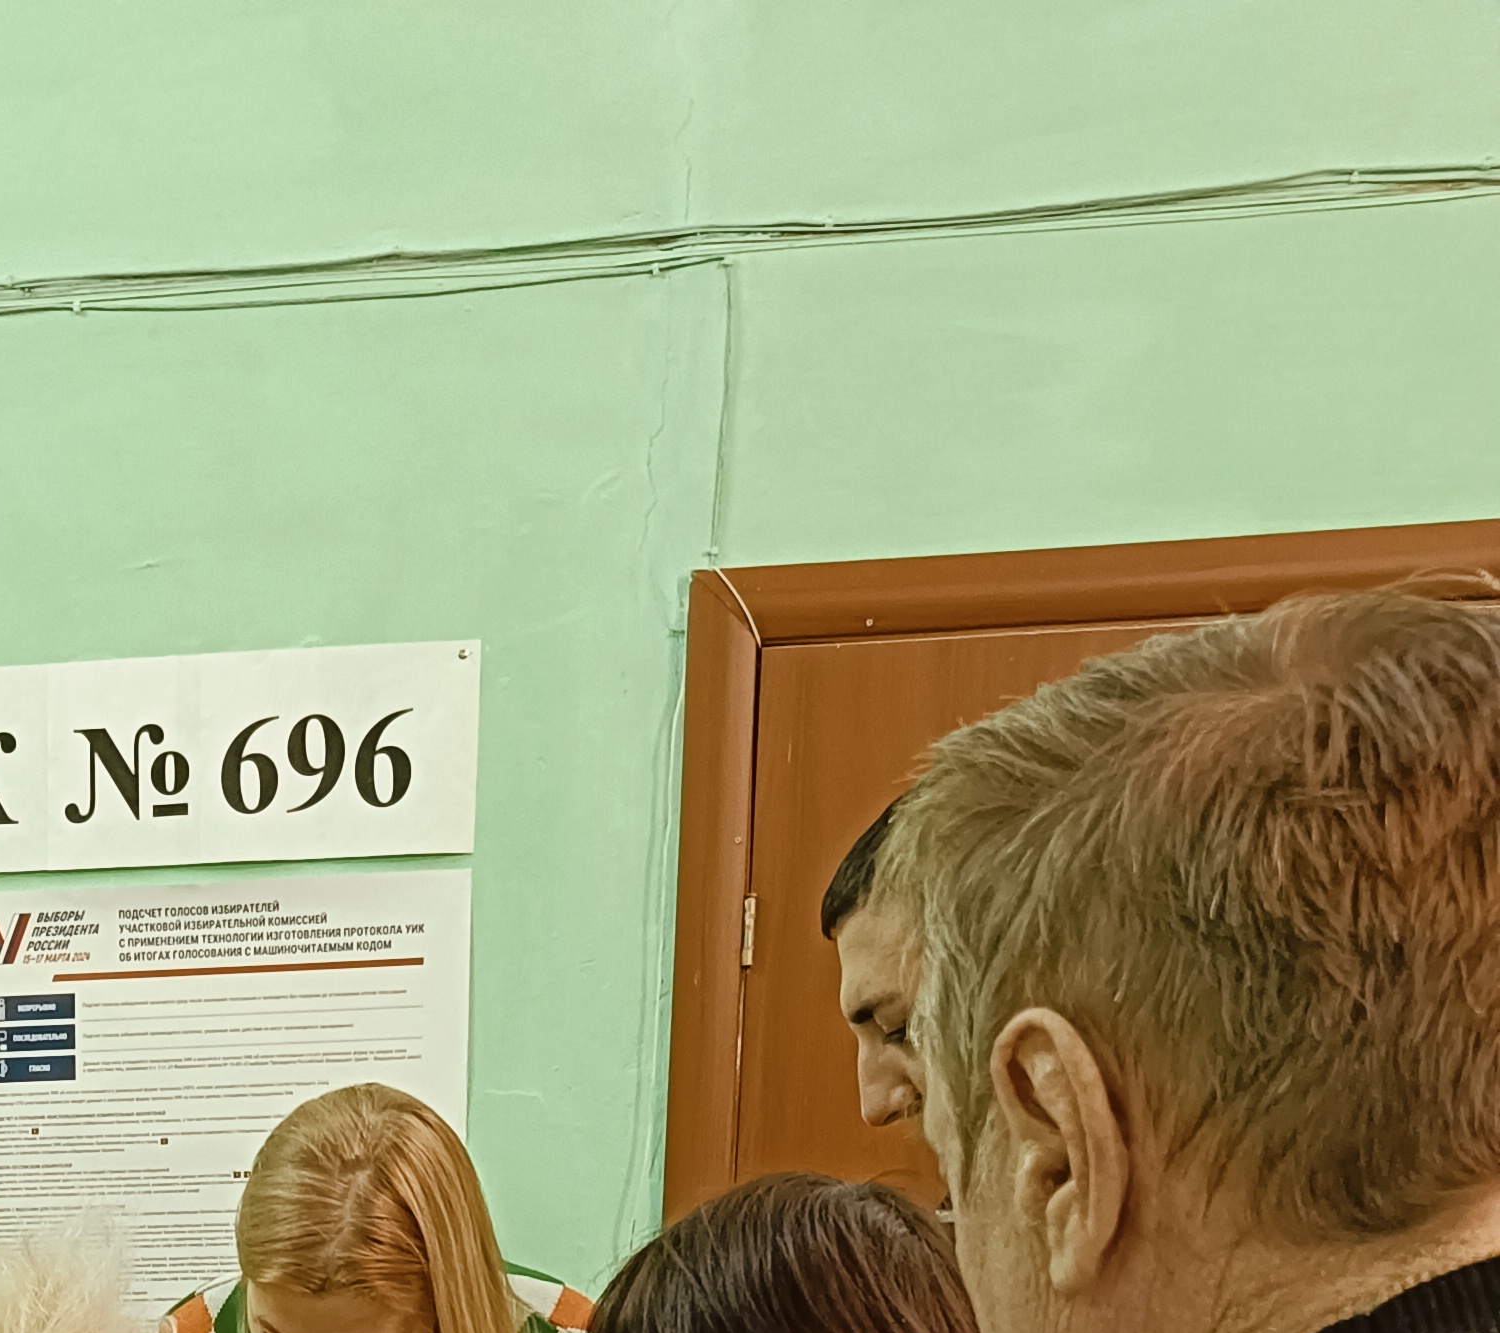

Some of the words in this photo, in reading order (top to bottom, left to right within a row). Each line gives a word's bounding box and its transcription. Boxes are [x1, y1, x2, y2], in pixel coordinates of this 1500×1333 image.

[64, 723, 190, 824] №
[220, 708, 414, 814] 696
[37, 910, 85, 923] ВЫБОРЫ
[118, 908, 163, 920] ПОДСЧЕТ
[165, 905, 209, 918] ГОЛОСОВ
[211, 900, 279, 914] ИЗБИРАТЕЛЕЙ
[31, 923, 100, 938] ПРЕЗИДЕНТА
[118, 920, 182, 934] УЧАСТКОВОЙ
[184, 915, 266, 931] ИЗБИРАТЕЛЬНОЙ
[268, 912, 328, 927] КОМИССИЕЙ
[26, 939, 70, 952] РОССИИ
[118, 939, 126, 949] С
[128, 935, 199, 948] ПРИМЕНЕНИЕМ
[201, 931, 264, 944] ТЕХНОЛОГИИ
[266, 928, 341, 941] ИЗГОТОВЛЕНИЯ
[343, 925, 403, 938] ПРОТОКОЛА
[405, 923, 425, 935] УИК
[44, 953, 70, 963] МАРТА
[72, 952, 91, 962] 2024
[118, 952, 132, 963] ОБ
[133, 950, 171, 962] ИТОГАХ
[172, 947, 242, 960] ГОЛОСОВАНИЯ
[244, 947, 252, 957] С
[253, 942, 354, 956] МАШИНОЧИТАЕМЫМ
[356, 940, 392, 953] КОДОМ
